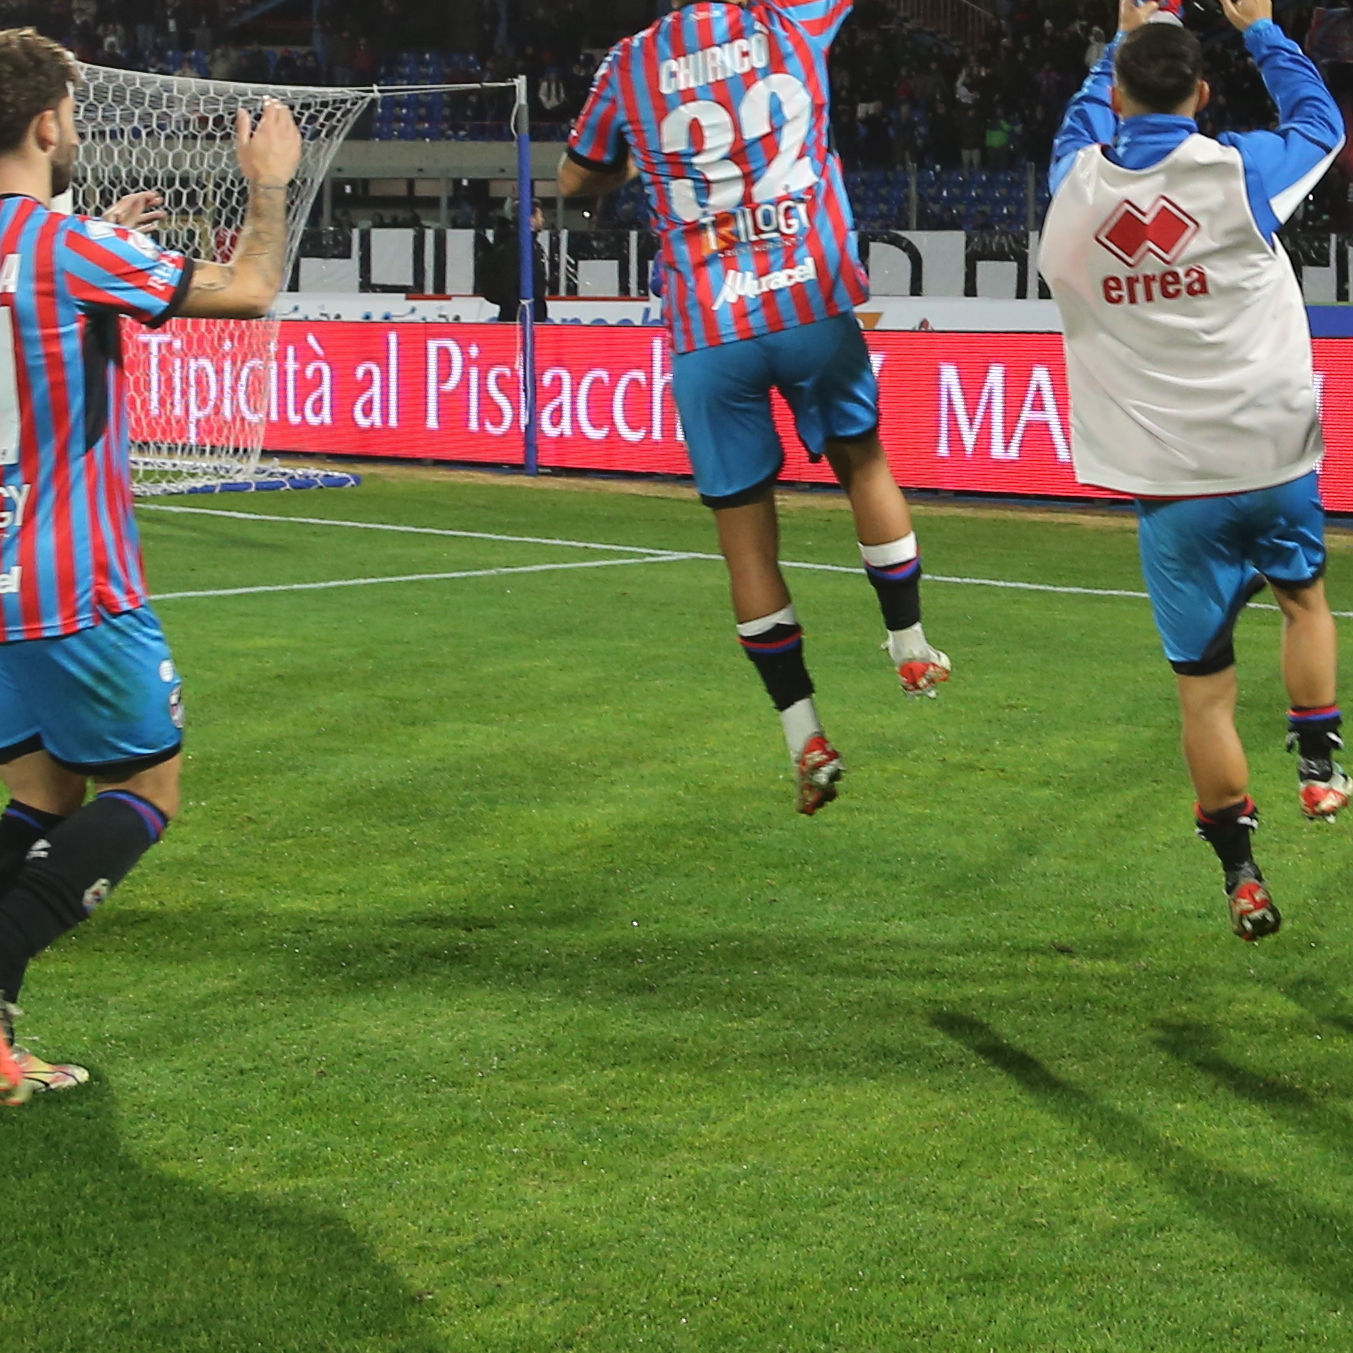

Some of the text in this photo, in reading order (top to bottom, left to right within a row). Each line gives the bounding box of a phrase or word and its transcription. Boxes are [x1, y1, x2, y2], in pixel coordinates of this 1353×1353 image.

[660, 73, 819, 222] 32
[134, 332, 333, 445] Tipicità
[353, 330, 398, 428] al
